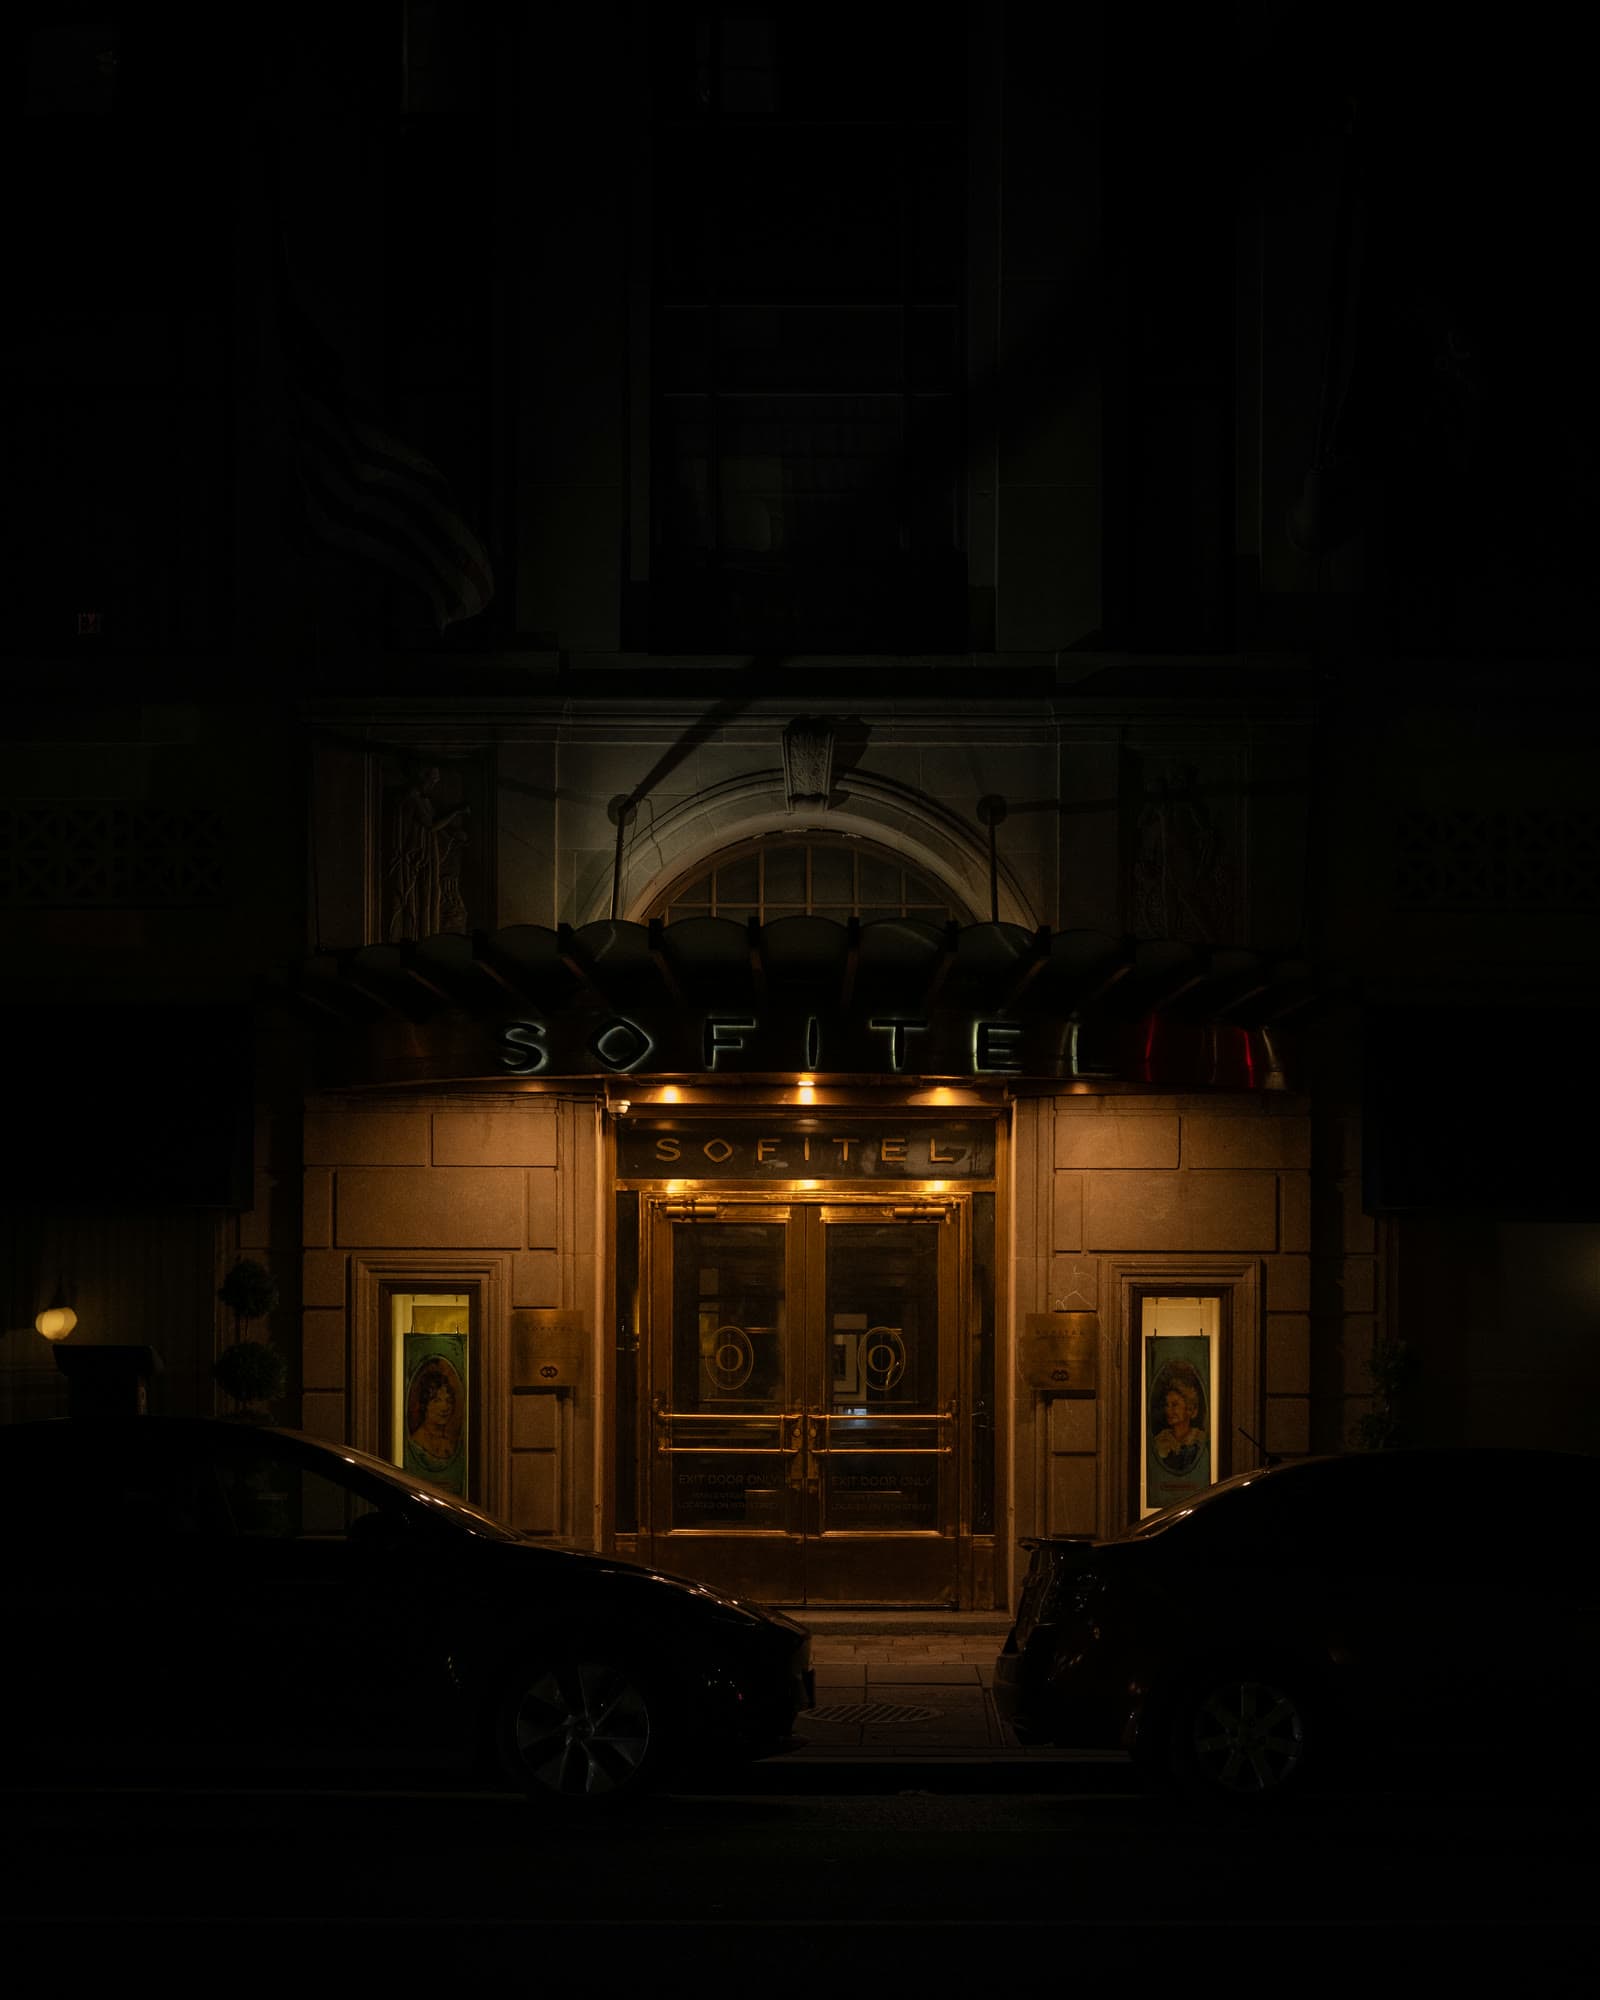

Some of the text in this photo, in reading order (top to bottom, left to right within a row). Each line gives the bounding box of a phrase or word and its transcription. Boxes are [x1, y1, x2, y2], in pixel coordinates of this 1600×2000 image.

[500, 1016, 1114, 1078] SOFITEL
[654, 1137, 955, 1163] SOFITEL
[679, 1473, 704, 1485] EXIT
[707, 1473, 744, 1485] DOOR
[860, 1475, 897, 1487] DOOR
